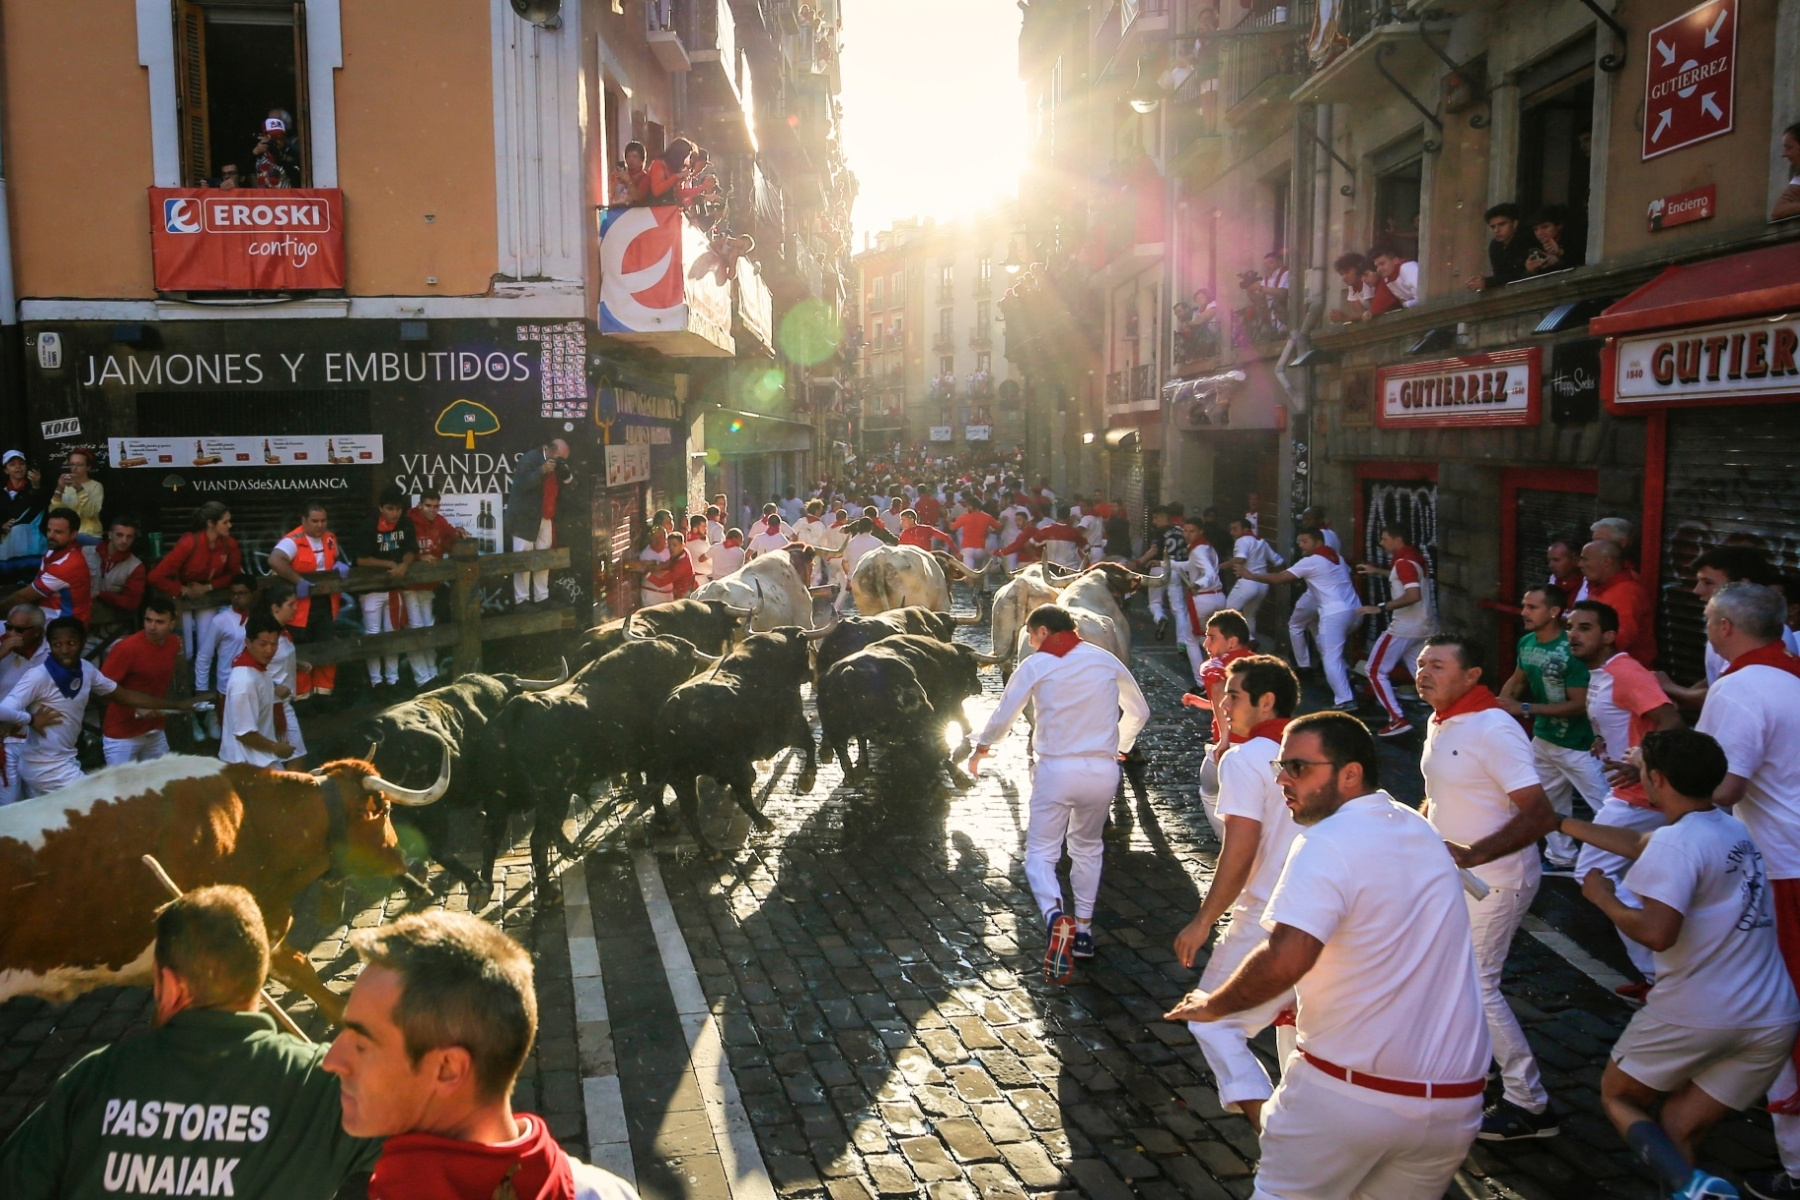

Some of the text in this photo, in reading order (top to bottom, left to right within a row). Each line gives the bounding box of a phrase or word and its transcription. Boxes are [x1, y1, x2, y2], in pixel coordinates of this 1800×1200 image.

[1651, 56, 1728, 99] GUTIERREZ
[213, 205, 320, 226] EROSKI
[1668, 196, 1708, 215] Encierro
[248, 234, 318, 268] contigo
[83, 353, 264, 386] JAMONES
[280, 353, 305, 383] Y
[325, 352, 530, 382] EMBUTIDOS
[1651, 327, 1799, 386] GUTIER
[1400, 371, 1508, 409] GUTIERREZ
[1626, 369, 1643, 379] 1840
[45, 420, 79, 435] KOKO
[193, 478, 348, 491] VIANDASdeSALAMANCA
[101, 1098, 270, 1142] PASTORES
[103, 1151, 240, 1197] UNAIAK
